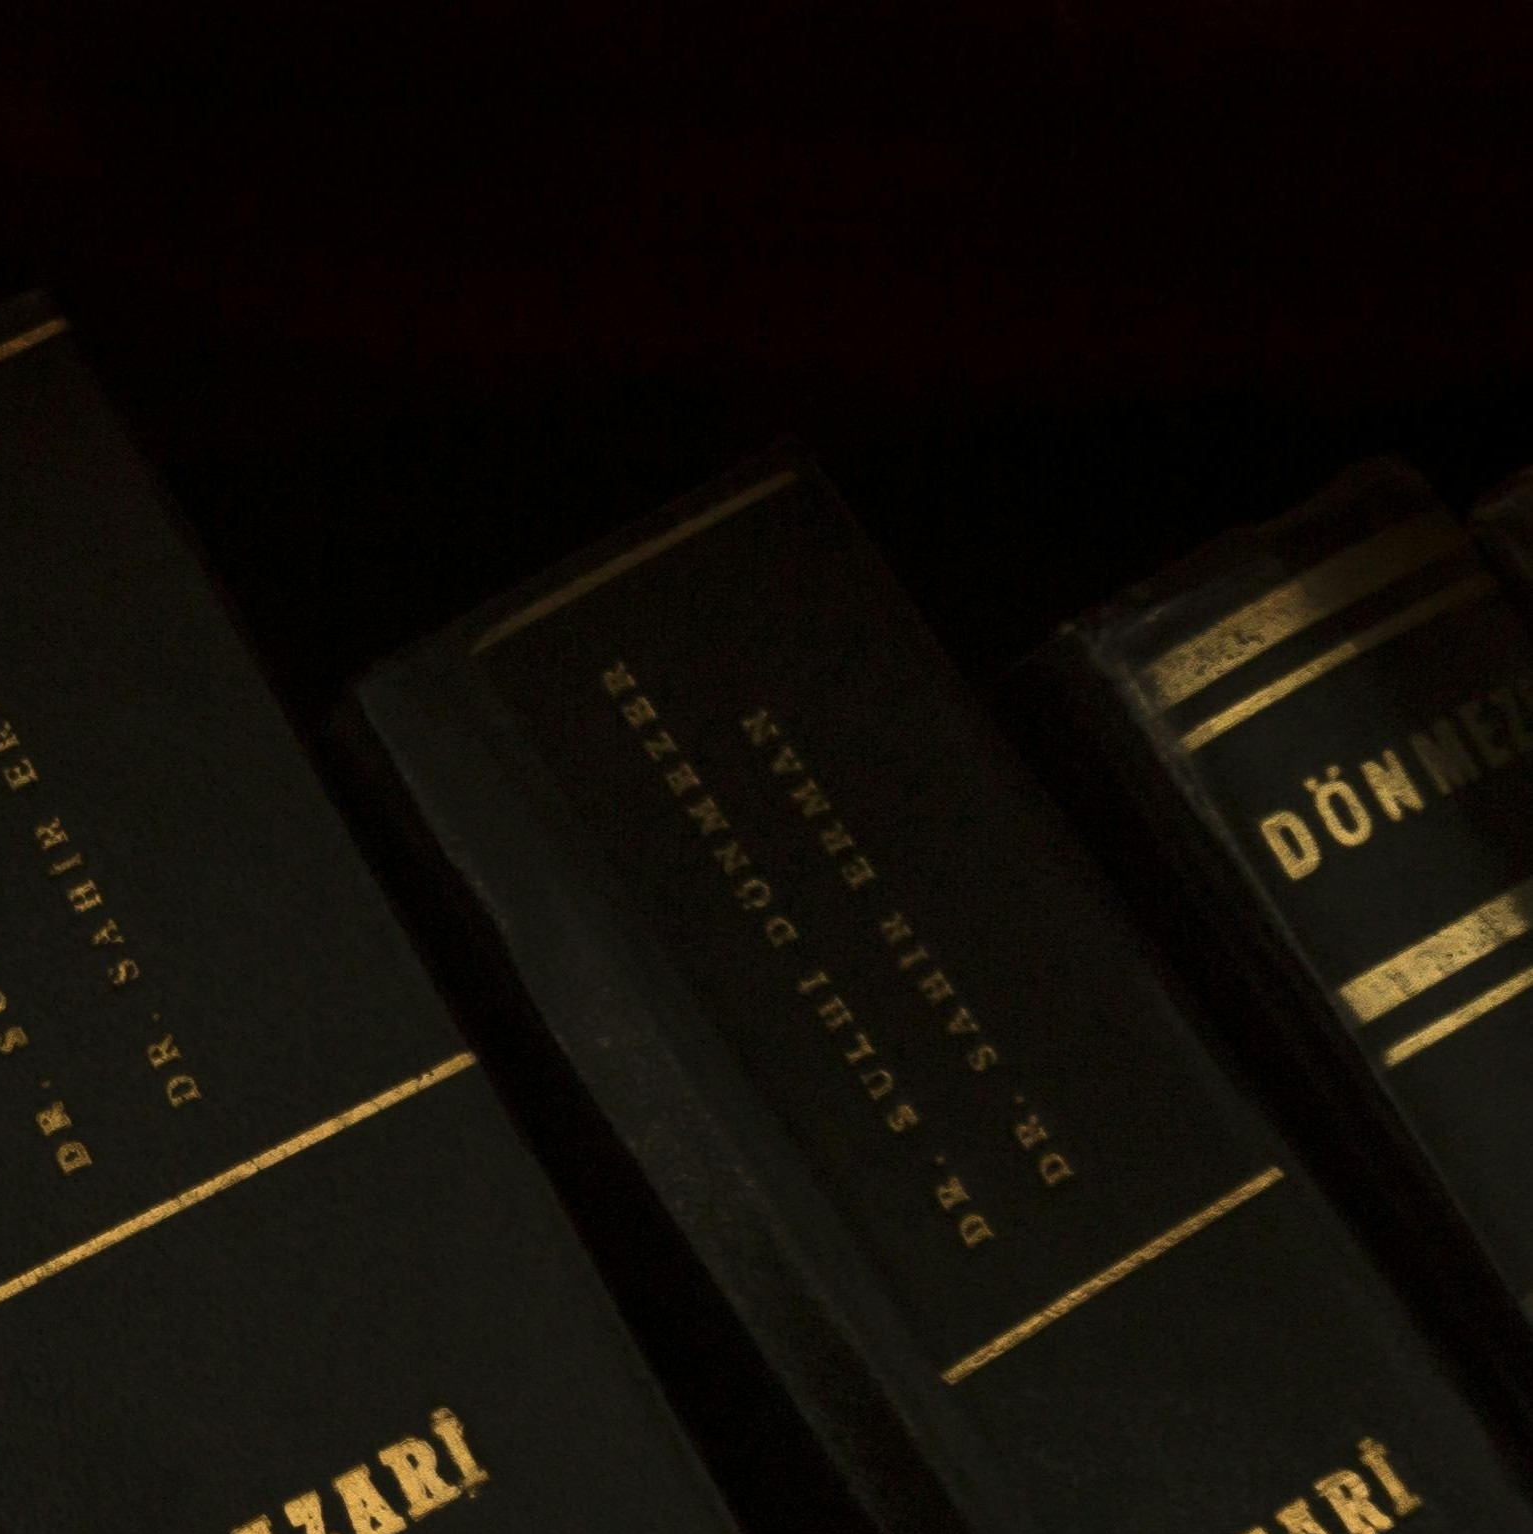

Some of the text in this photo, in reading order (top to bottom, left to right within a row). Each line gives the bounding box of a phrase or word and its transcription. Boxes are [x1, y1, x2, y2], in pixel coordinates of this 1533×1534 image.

[742, 708, 877, 890] ERMAN
[146, 1011, 202, 1108] DR.
[34, 1078, 93, 1176] DR.
[1014, 1095, 1075, 1186] DR.
[934, 1155, 996, 1248] DR.
